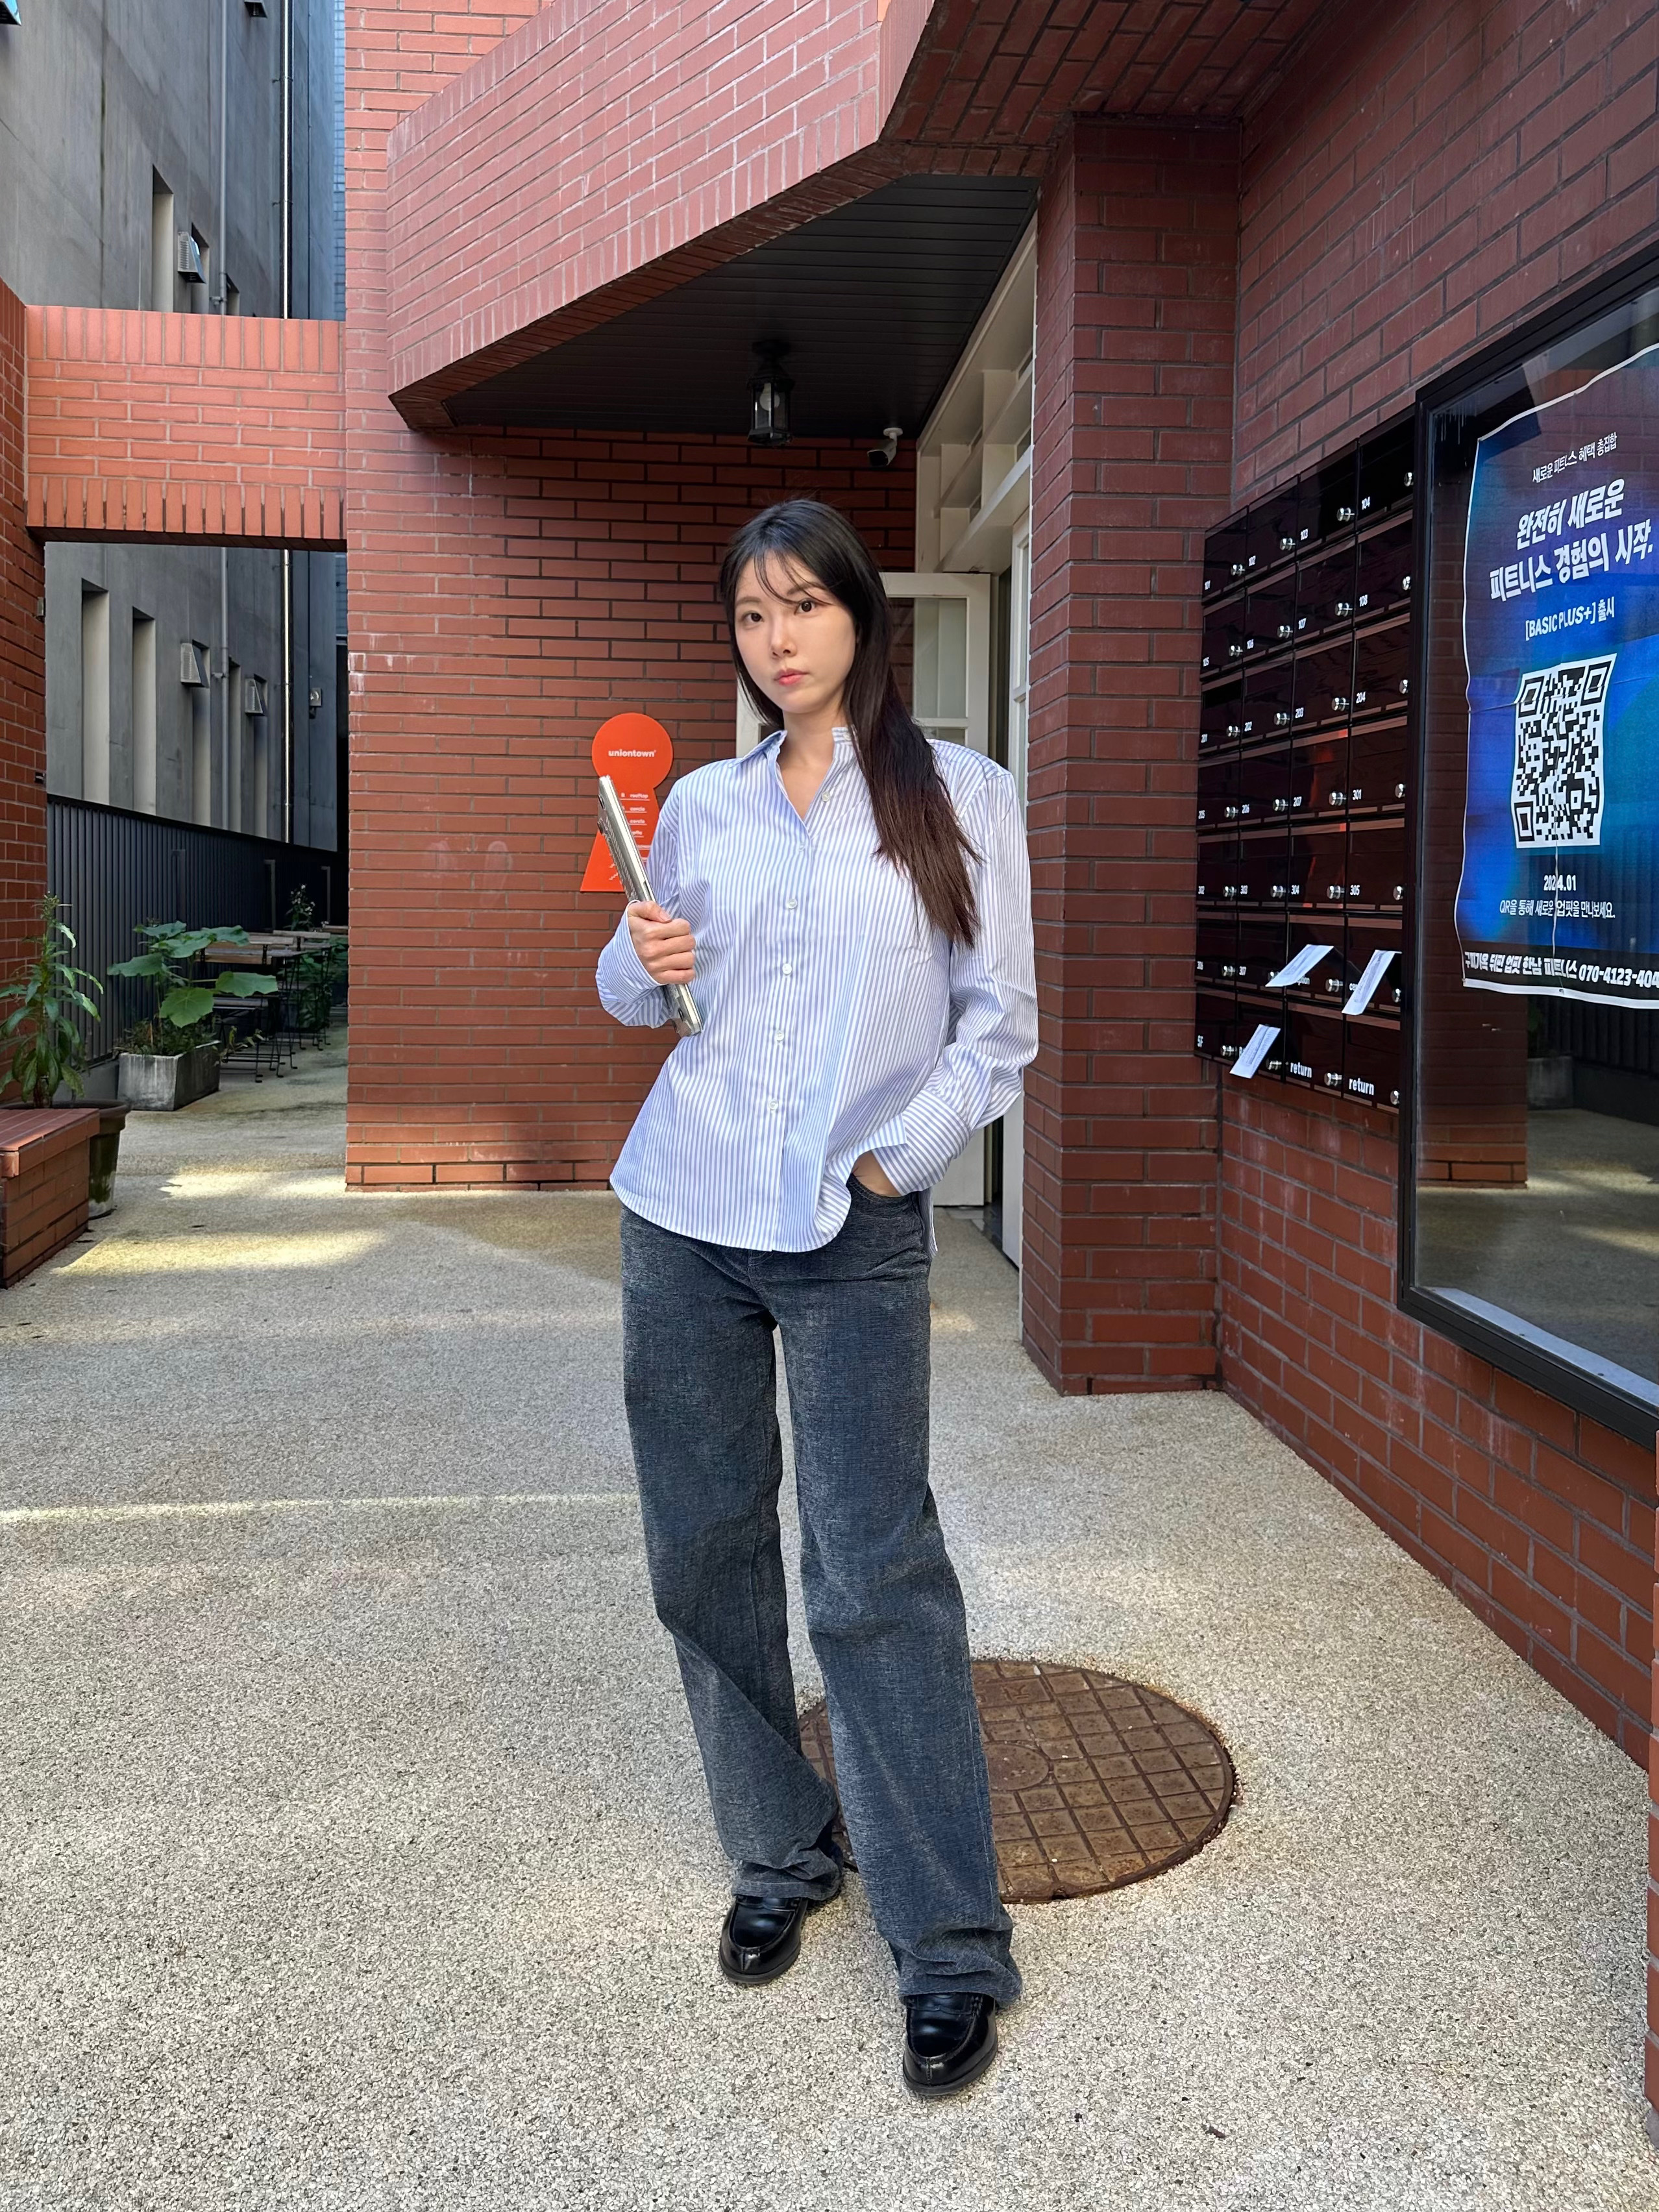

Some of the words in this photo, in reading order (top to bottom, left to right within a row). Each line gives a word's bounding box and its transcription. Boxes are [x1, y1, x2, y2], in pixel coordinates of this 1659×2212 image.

[1532, 462, 1553, 483] 새로운
[1579, 442, 1595, 461] 혜택
[1362, 497, 1370, 510] 104
[1516, 498, 1567, 550] 완전히
[1567, 478, 1625, 528] 새로운
[1490, 555, 1553, 601] 피트니스
[1554, 532, 1609, 583] 경험의
[1615, 519, 1653, 564] 시작.
[1359, 595, 1368, 607] 108
[1525, 613, 1558, 641] [BASIC
[1558, 602, 1596, 630] PLUS+]
[1597, 596, 1615, 622] 출시
[1356, 692, 1366, 704] 204
[1295, 707, 1303, 718] 203
[1353, 789, 1361, 800] 301
[1350, 885, 1360, 895] 305
[1543, 874, 1577, 891] 2024.01
[1499, 899, 1518, 916] QR을
[1518, 900, 1534, 916] 통해
[1534, 900, 1555, 916] 새로운
[1556, 900, 1580, 918] 업핏을
[1580, 900, 1616, 919] 만나보세요.
[1504, 955, 1523, 975] 업핏
[1522, 955, 1543, 976] 한남
[1290, 1061, 1312, 1078] return
[1349, 1077, 1375, 1096] return
